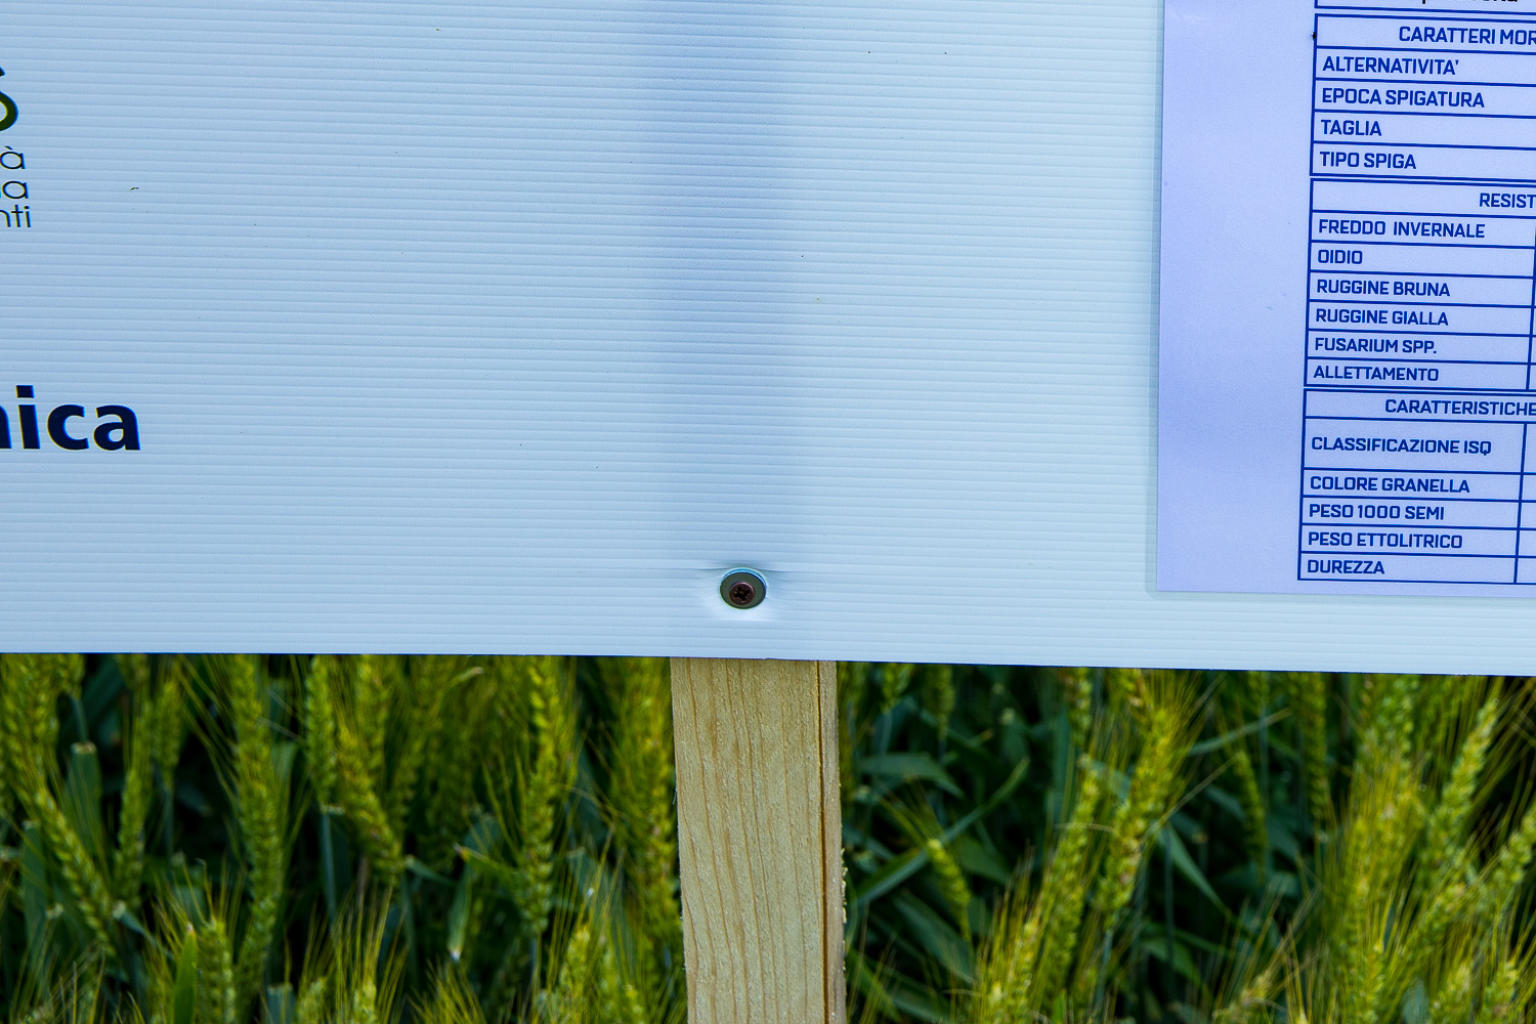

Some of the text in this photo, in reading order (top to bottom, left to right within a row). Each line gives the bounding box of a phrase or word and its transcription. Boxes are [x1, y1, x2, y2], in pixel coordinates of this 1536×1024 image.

[1399, 25, 1496, 45] CARATTERI
[1322, 56, 1459, 77] ALTERNATIVITA'
[1322, 87, 1485, 108] EPOCA SPIGATURA
[1321, 119, 1383, 138] TAGLIA
[1319, 151, 1417, 170] TIPO SPIGA
[1318, 219, 1486, 239] FREDDO INVERNALE
[1317, 249, 1363, 266] OIDIO
[1316, 279, 1451, 299] RUGGINE BRUNA
[1315, 308, 1449, 327] RUGGINE GIALLA
[1314, 337, 1437, 356] FUSARIUM SPP.
[1313, 365, 1439, 383] ALLETTAMENTO
[0, 384, 141, 451] ica
[1311, 436, 1492, 457] CLASSIFICAZIONE ISQ
[1309, 475, 1470, 495] COLORE GRANELLA
[1309, 503, 1445, 522] PESO 1000 SEMI
[1307, 531, 1463, 550] PESO ETTOLITRICO
[1307, 559, 1385, 576] DUREZZA
